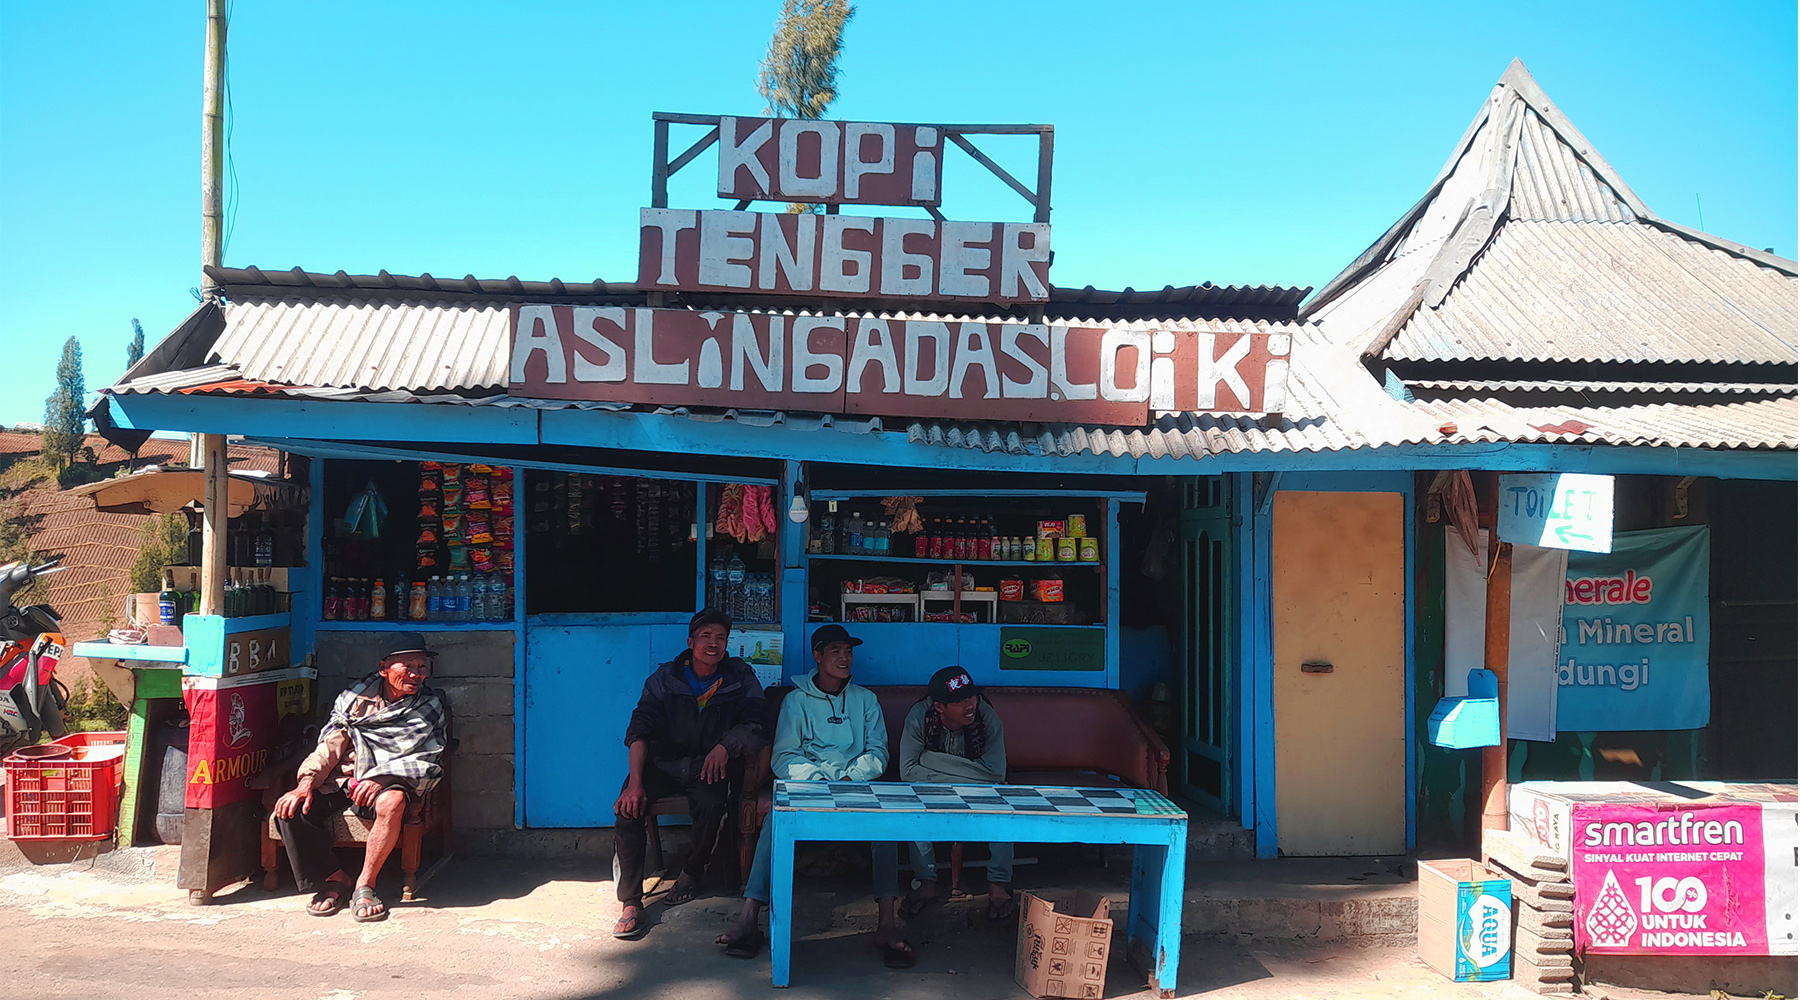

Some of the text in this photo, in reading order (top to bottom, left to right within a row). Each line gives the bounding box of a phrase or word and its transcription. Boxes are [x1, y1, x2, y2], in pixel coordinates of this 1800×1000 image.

[1578, 616, 1694, 645] Mineral
[1005, 644, 1029, 653] RAPI
[1558, 659, 1649, 691] dungi
[190, 749, 268, 785] ARMOUR
[1584, 812, 1744, 846] smartfren
[1584, 852, 1743, 863] SINYAL KUAT INTERNET CEPAT
[1479, 905, 1498, 957] AQUA
[1642, 914, 1707, 930] UNTUK
[1641, 932, 1747, 948] INDONESIA
